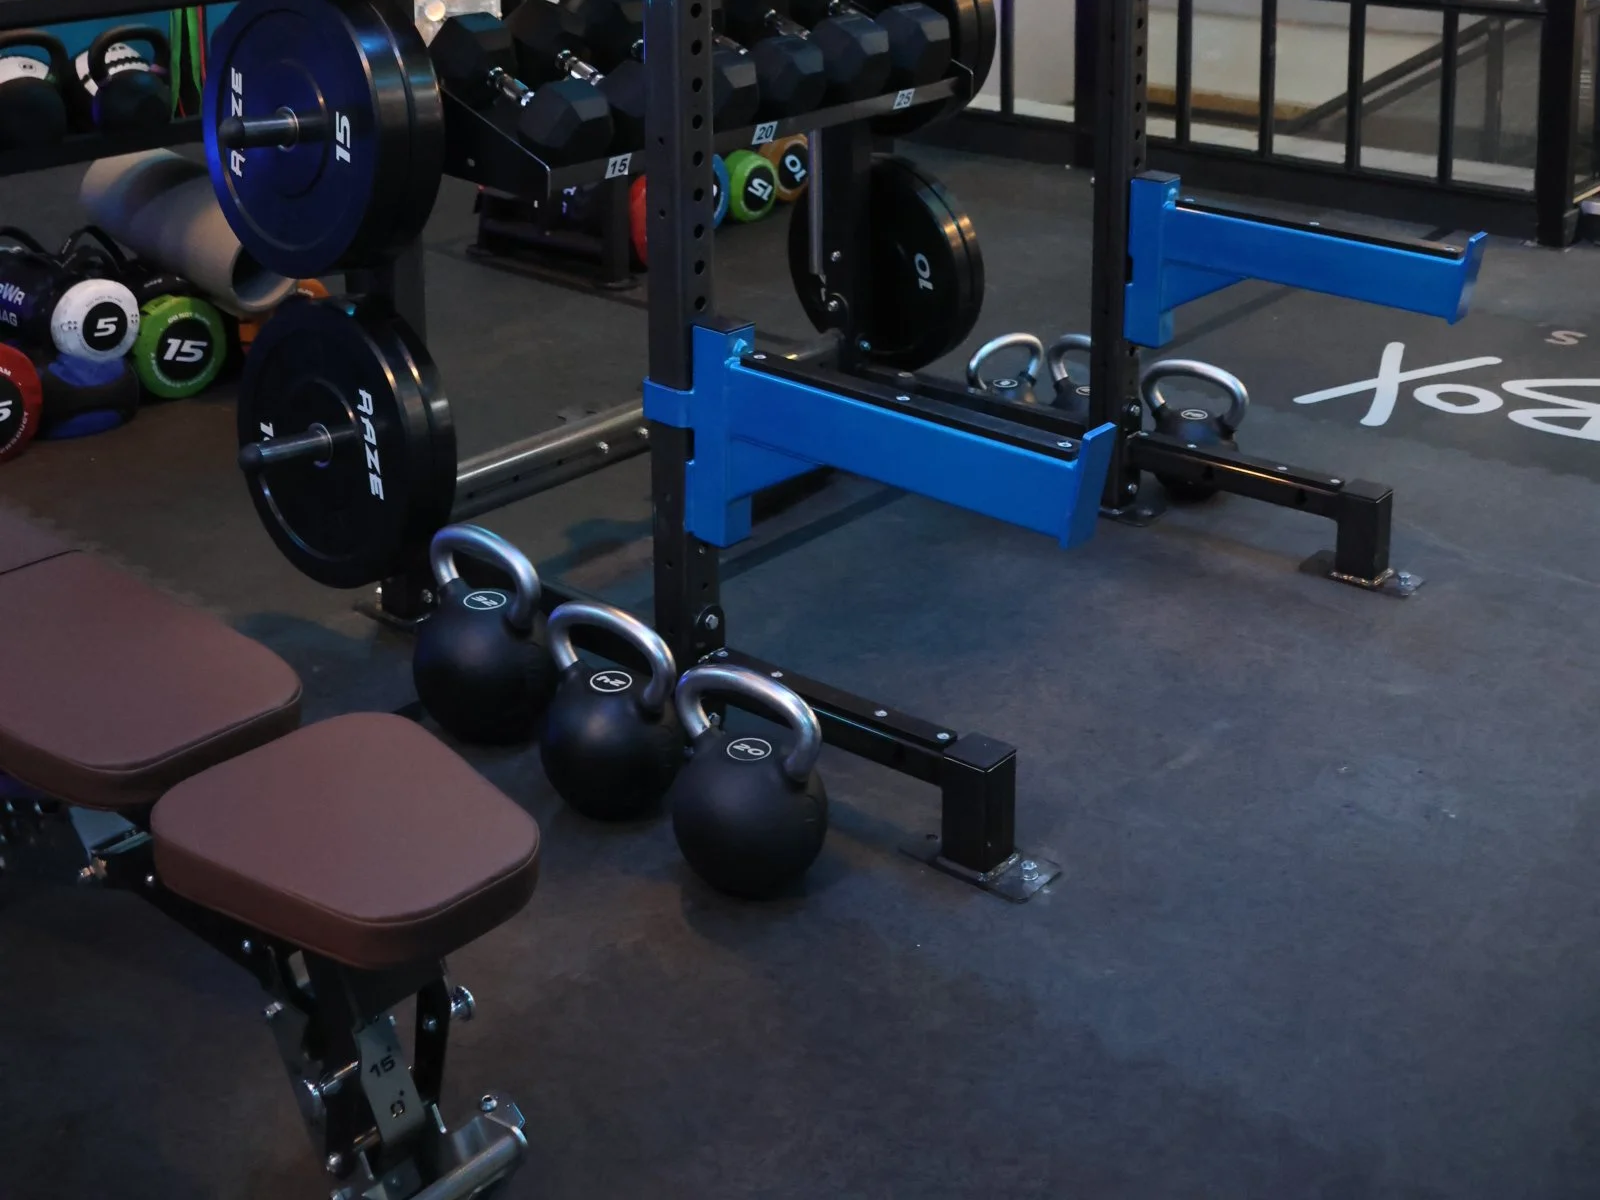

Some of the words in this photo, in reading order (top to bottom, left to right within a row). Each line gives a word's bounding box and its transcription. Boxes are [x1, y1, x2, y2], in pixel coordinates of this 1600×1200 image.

[230, 67, 246, 177] RZE
[756, 125, 773, 140] 20
[335, 111, 351, 164] 15
[609, 157, 628, 174] 15
[785, 154, 807, 182] 10
[747, 178, 773, 201] 15
[915, 252, 933, 290] 10
[94, 316, 119, 337] 5
[163, 338, 208, 362] 15
[357, 388, 385, 501] RAZE
[732, 743, 765, 756] 20
